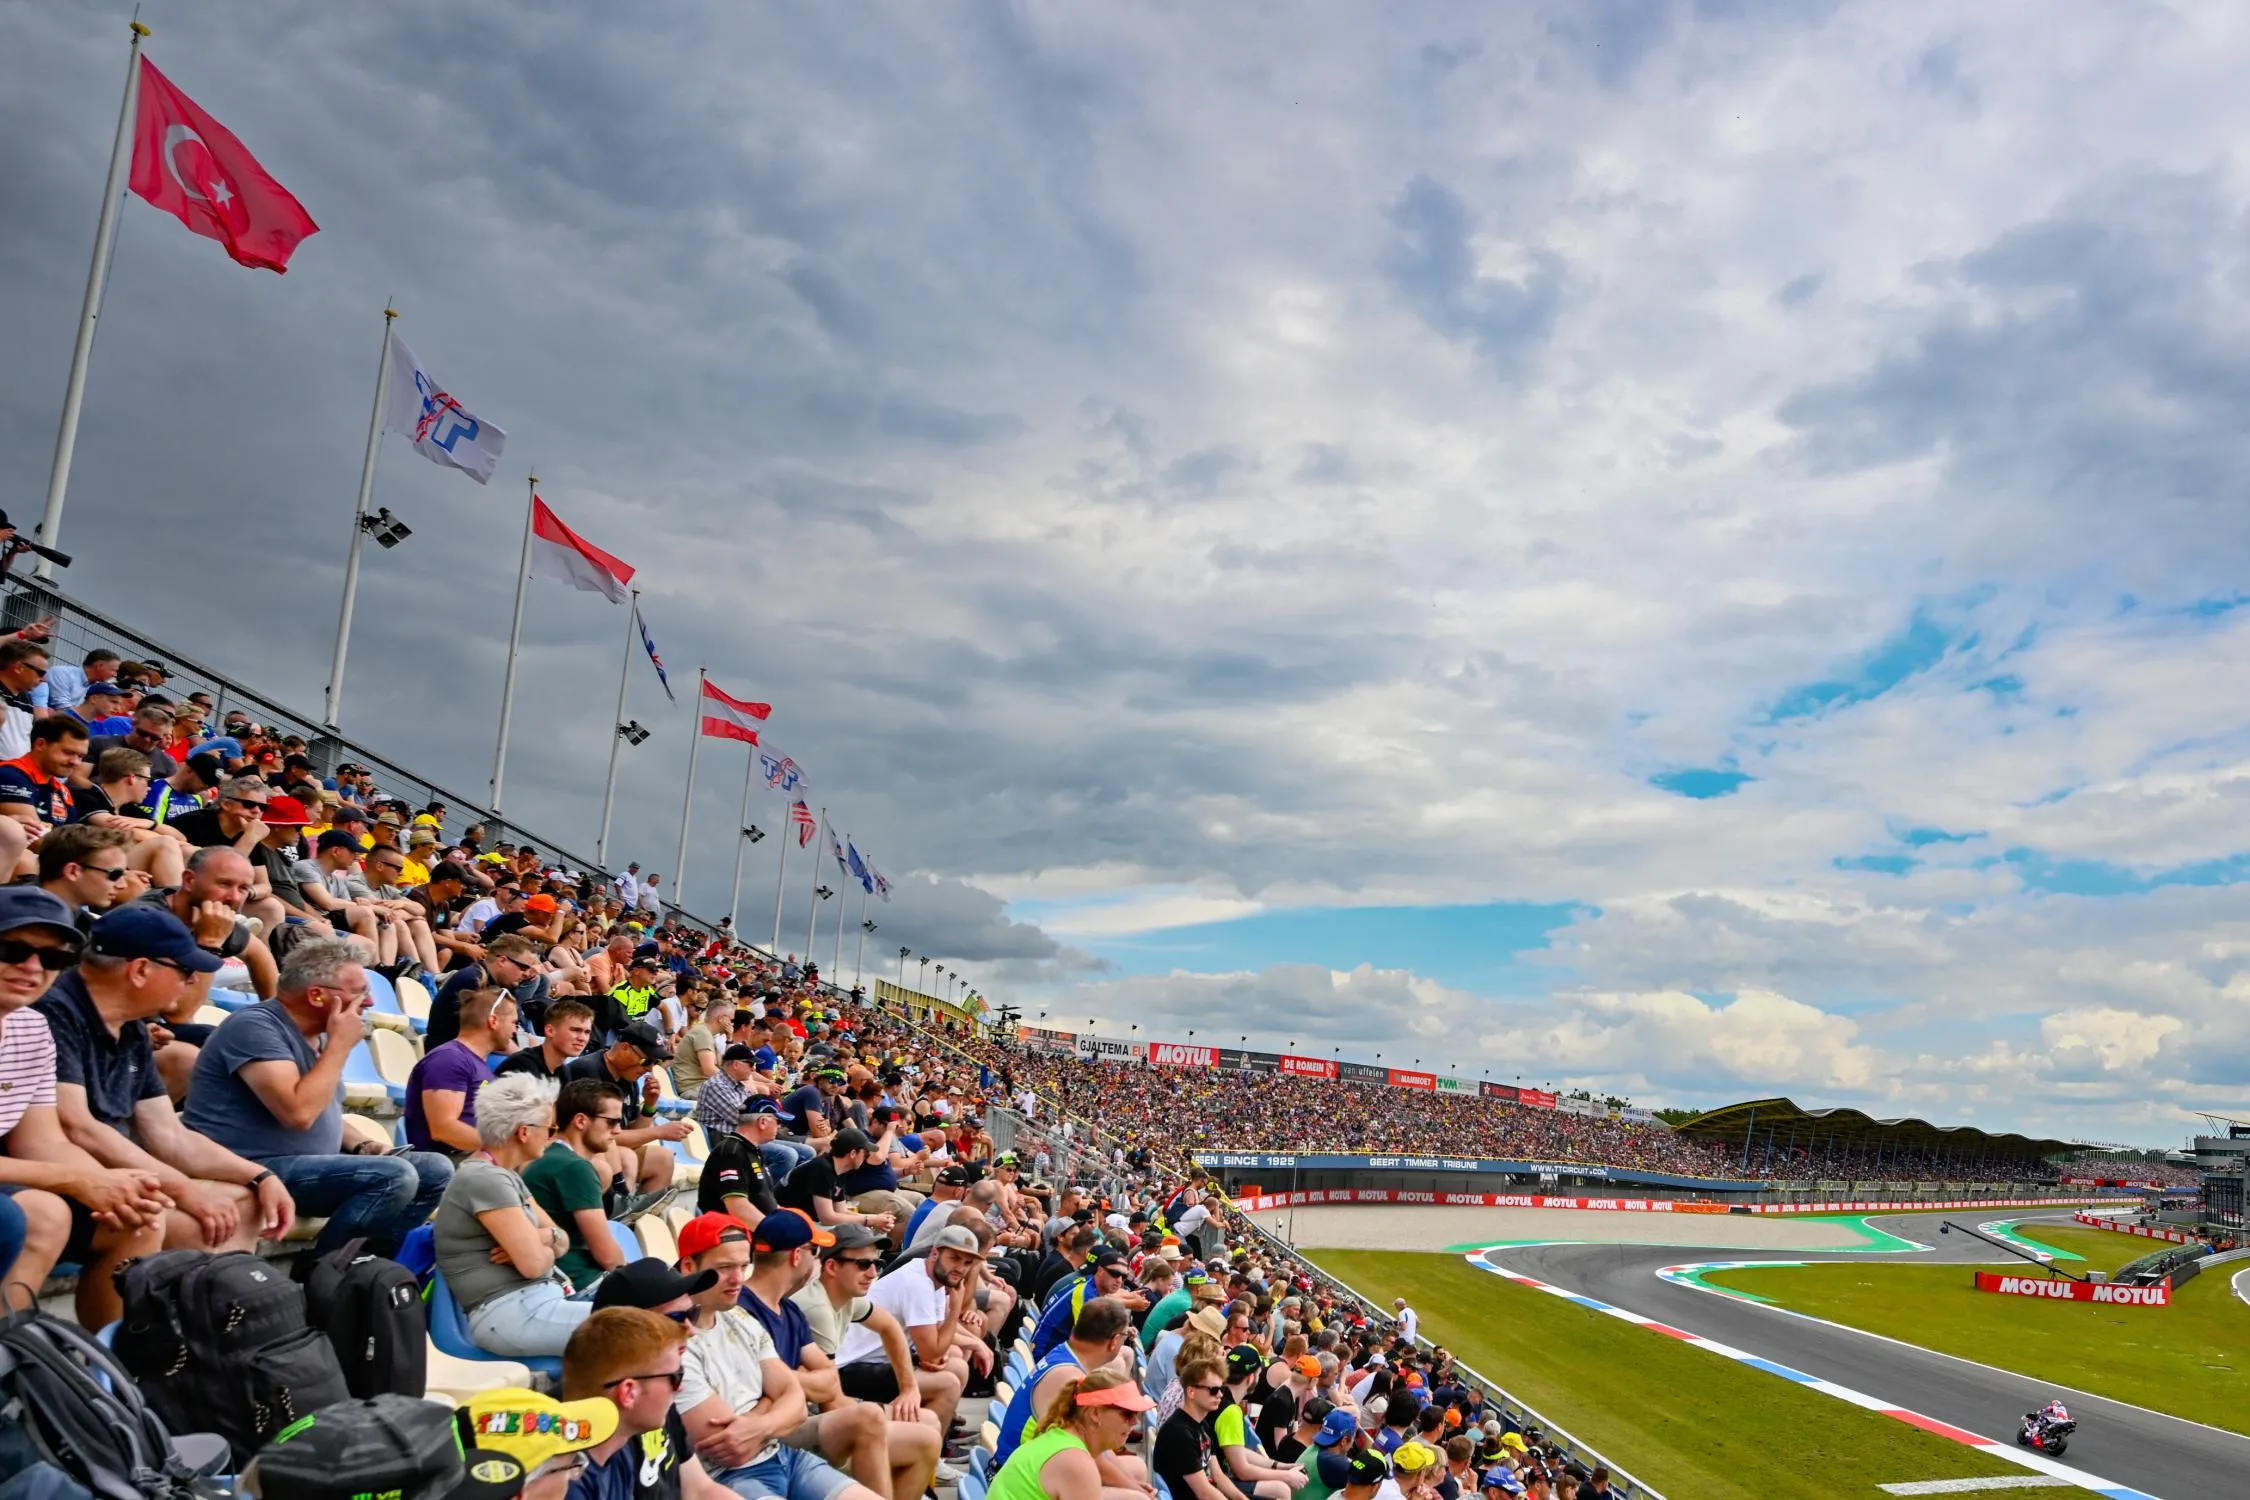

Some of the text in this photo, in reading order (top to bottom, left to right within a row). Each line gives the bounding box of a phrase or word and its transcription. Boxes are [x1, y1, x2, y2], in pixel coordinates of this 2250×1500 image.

[1155, 1044, 1213, 1066] MOTUL
[1284, 1058, 1295, 1070] DE
[1295, 1060, 1325, 1073] ROMEIN
[1343, 1066, 1356, 1075] van
[1358, 1067, 1384, 1079] uffelen
[1400, 1074, 1432, 1086] MAMMOET
[1436, 1077, 1458, 1090] TVM
[1223, 1155, 1259, 1166] SINCE
[1266, 1156, 1295, 1166] 1925
[1369, 1157, 1478, 1169] GEERT TIMMER TRIBUNE
[1329, 1190, 1351, 1201] MOTUL
[1358, 1190, 1389, 1201] MOTUL
[1396, 1191, 1436, 1202] MOTUL
[1446, 1193, 1485, 1205] MOTUL
[1495, 1195, 1533, 1207] MOTUL
[1542, 1197, 1578, 1209] MOTUL
[1587, 1199, 1618, 1210] MOTUL
[1624, 1200, 1648, 1211] MOTUL
[1652, 1201, 1674, 1211] MOTUL
[1998, 1277, 2166, 1305] MOTUL MOTUL
[479, 1409, 592, 1442] THE DOCTOR
